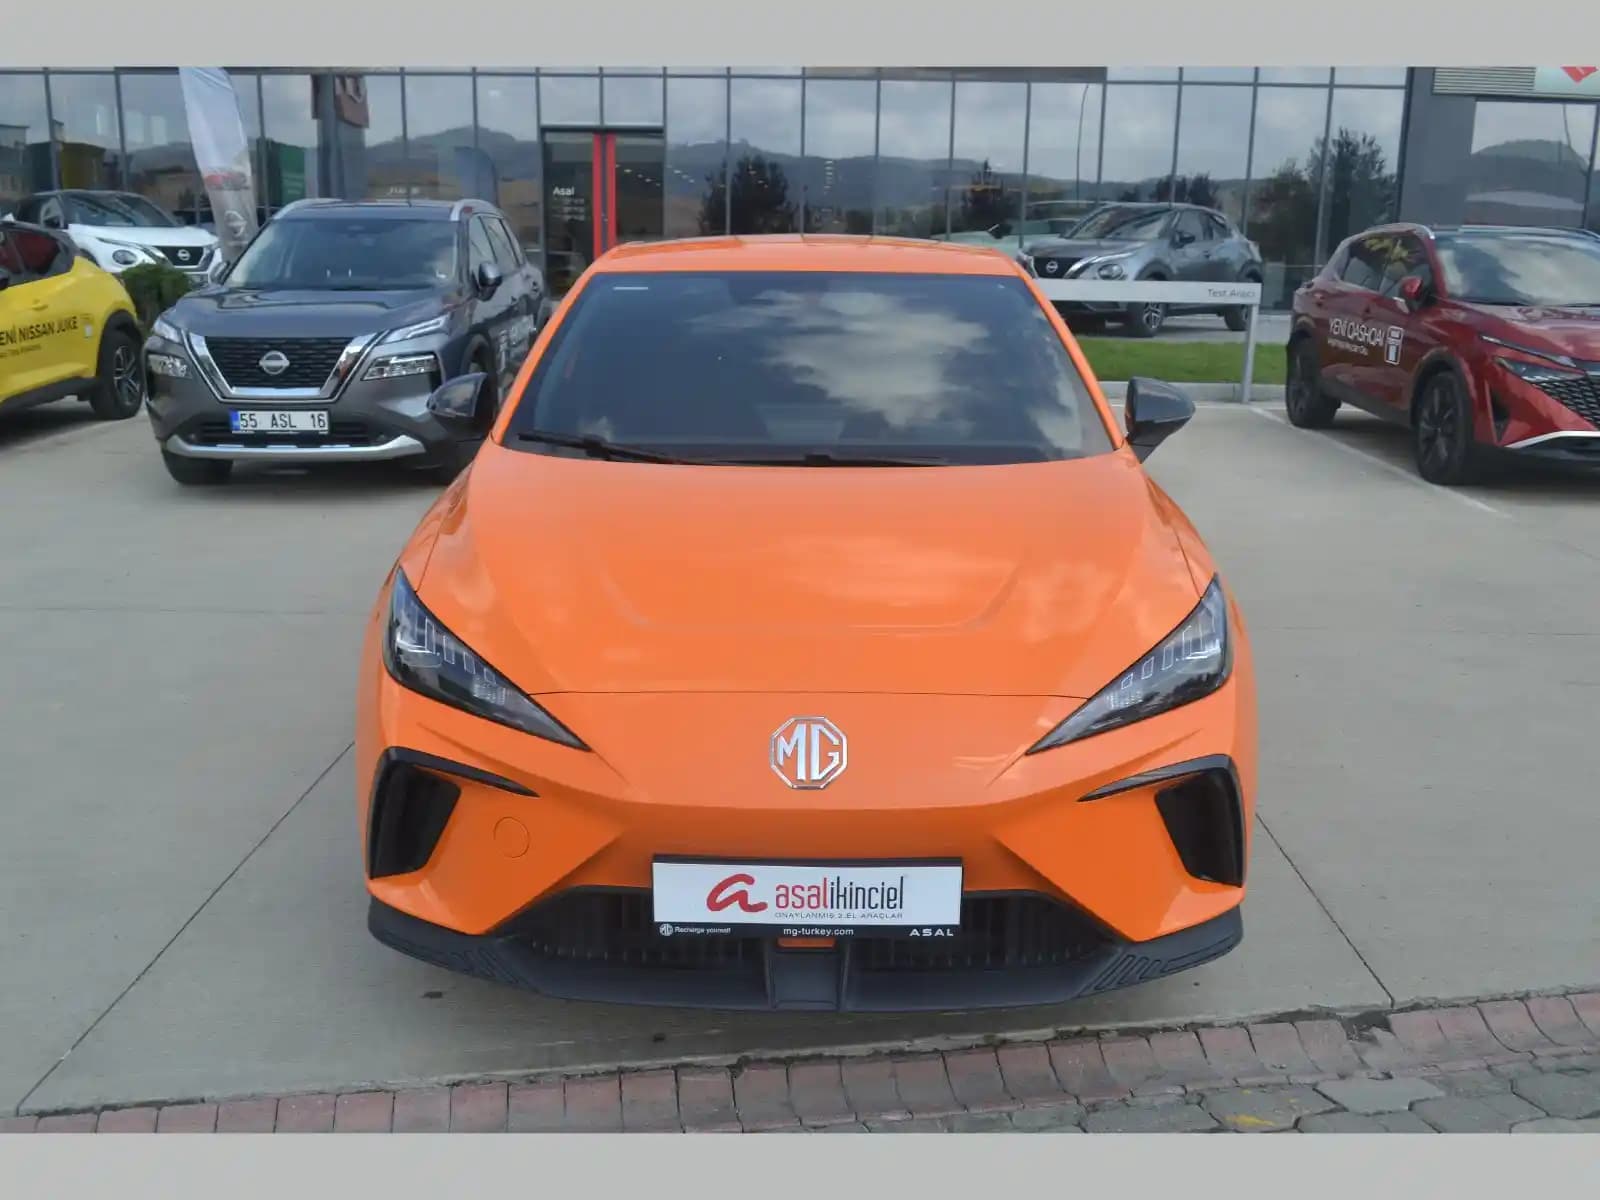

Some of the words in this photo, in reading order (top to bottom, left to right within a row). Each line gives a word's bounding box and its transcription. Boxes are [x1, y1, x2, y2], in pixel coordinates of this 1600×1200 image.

[1207, 288, 1227, 298] Test
[19, 321, 55, 341] NISSAN
[56, 315, 78, 334] JUKE
[240, 413, 258, 428] 55
[271, 413, 297, 428] ASL
[310, 413, 326, 428] 16
[777, 722, 840, 781] MG
[674, 926, 705, 935] Recharge
[706, 926, 732, 935] yourself
[783, 927, 854, 937] mg-turkey.com
[909, 928, 954, 937] ASAL
